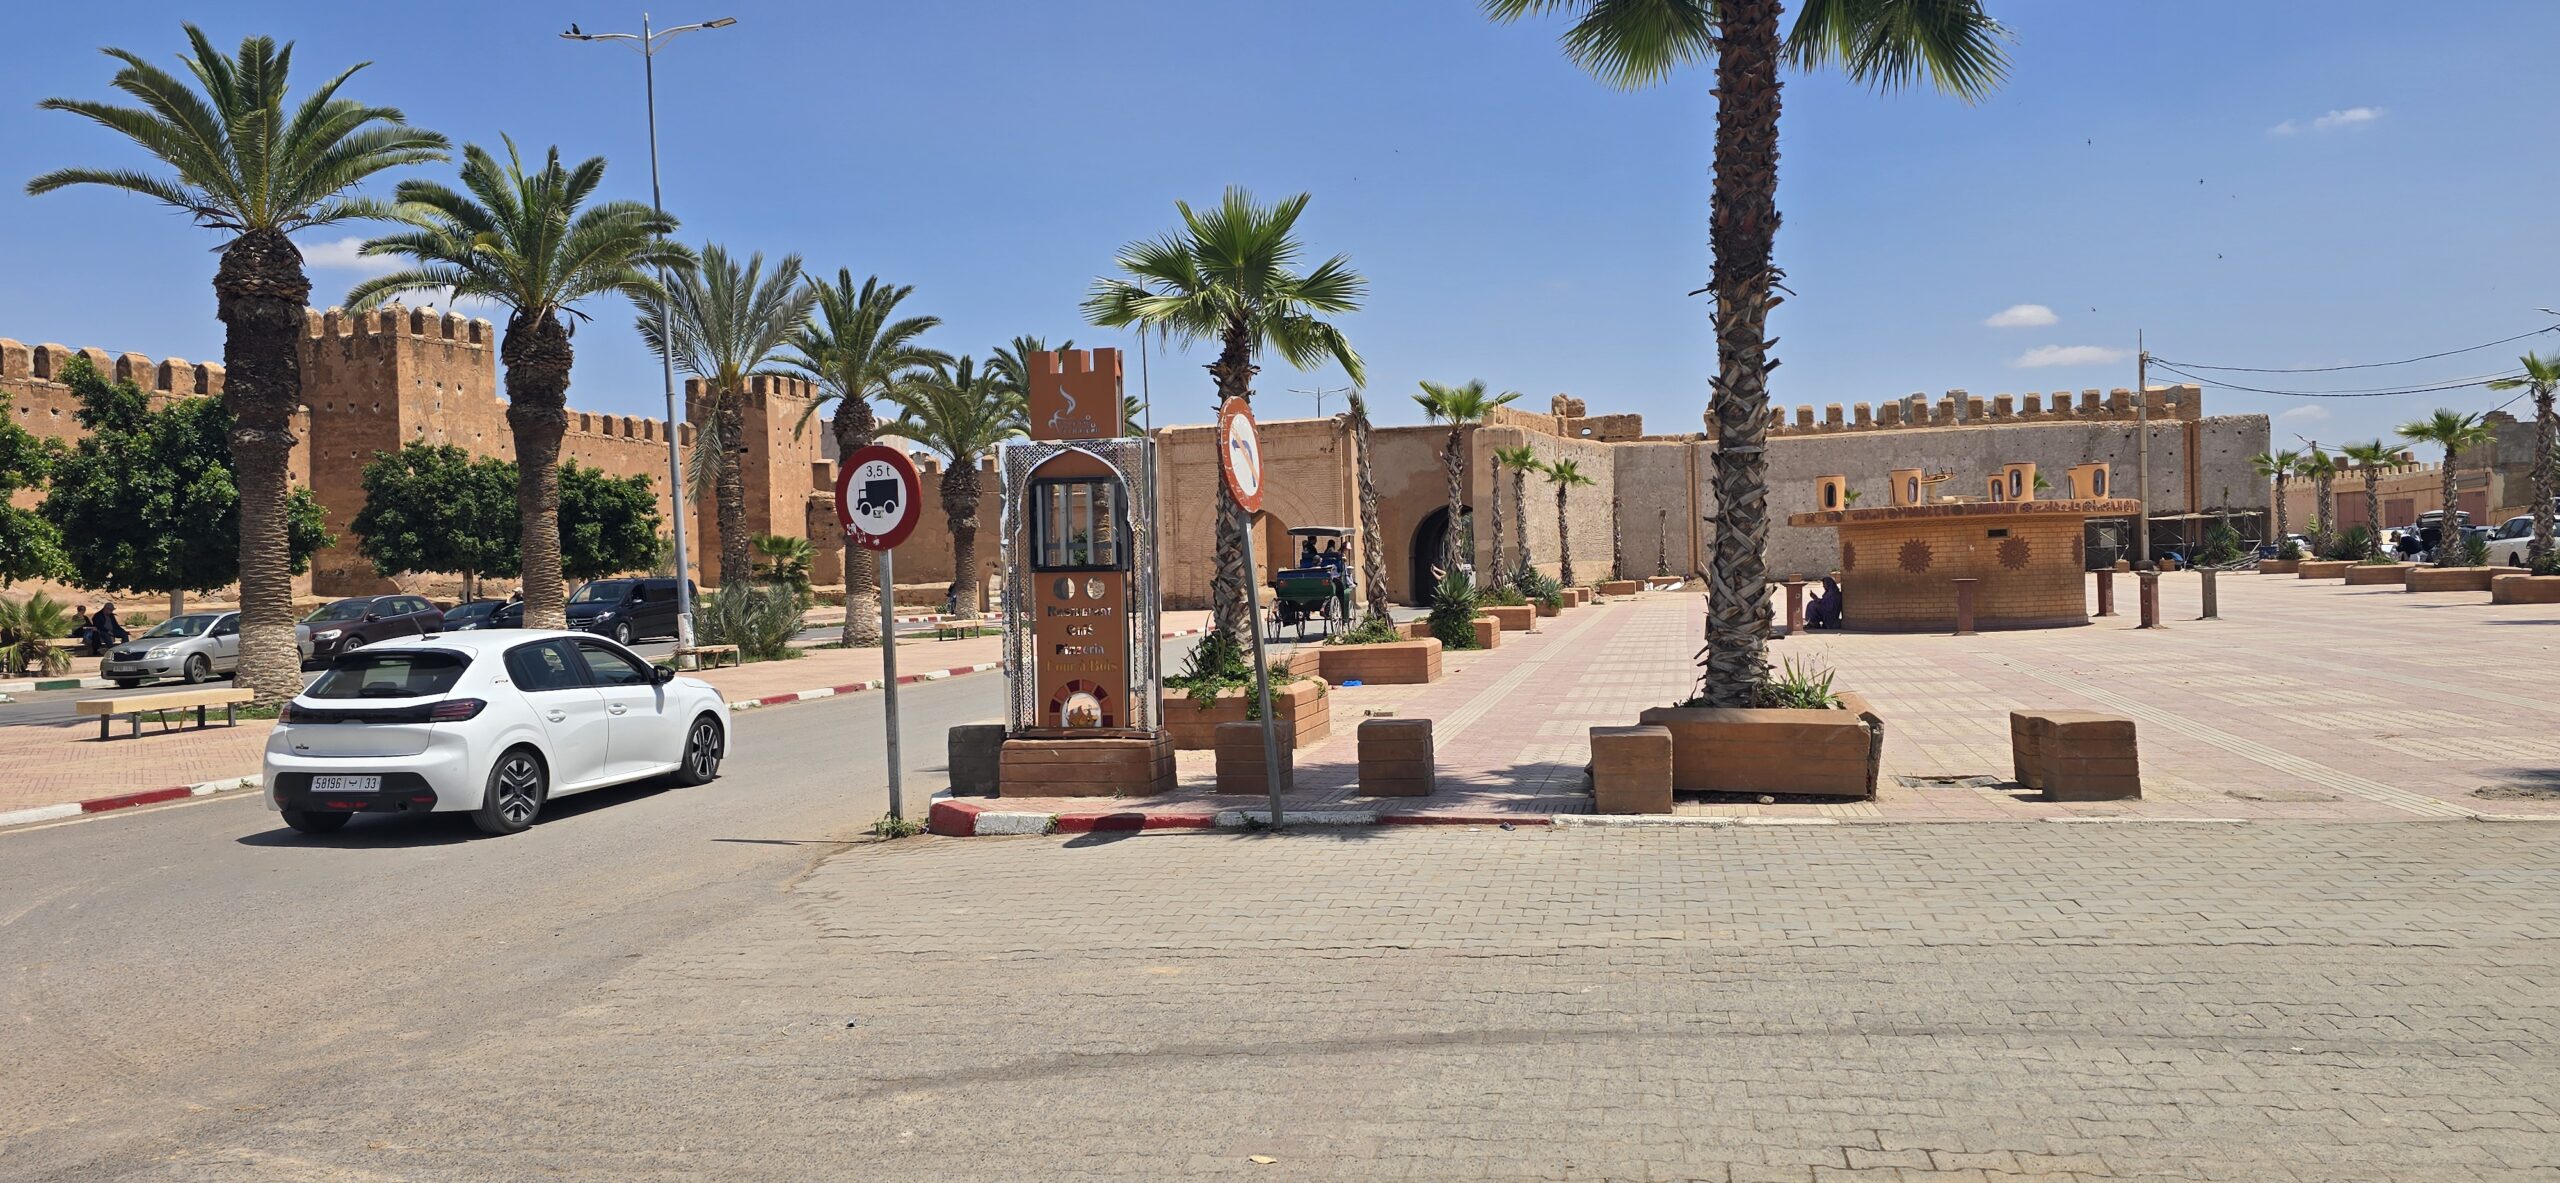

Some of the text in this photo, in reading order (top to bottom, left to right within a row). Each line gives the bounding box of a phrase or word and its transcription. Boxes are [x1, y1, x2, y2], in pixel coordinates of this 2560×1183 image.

[866, 465, 890, 478] 3,5 t
[1047, 606, 1112, 617] Restaurant
[1056, 642, 1105, 655] Pizzeria
[1046, 659, 1076, 673] Four
[1089, 659, 1118, 673] Bois
[315, 777, 342, 789] 58196
[364, 777, 377, 789] 33
